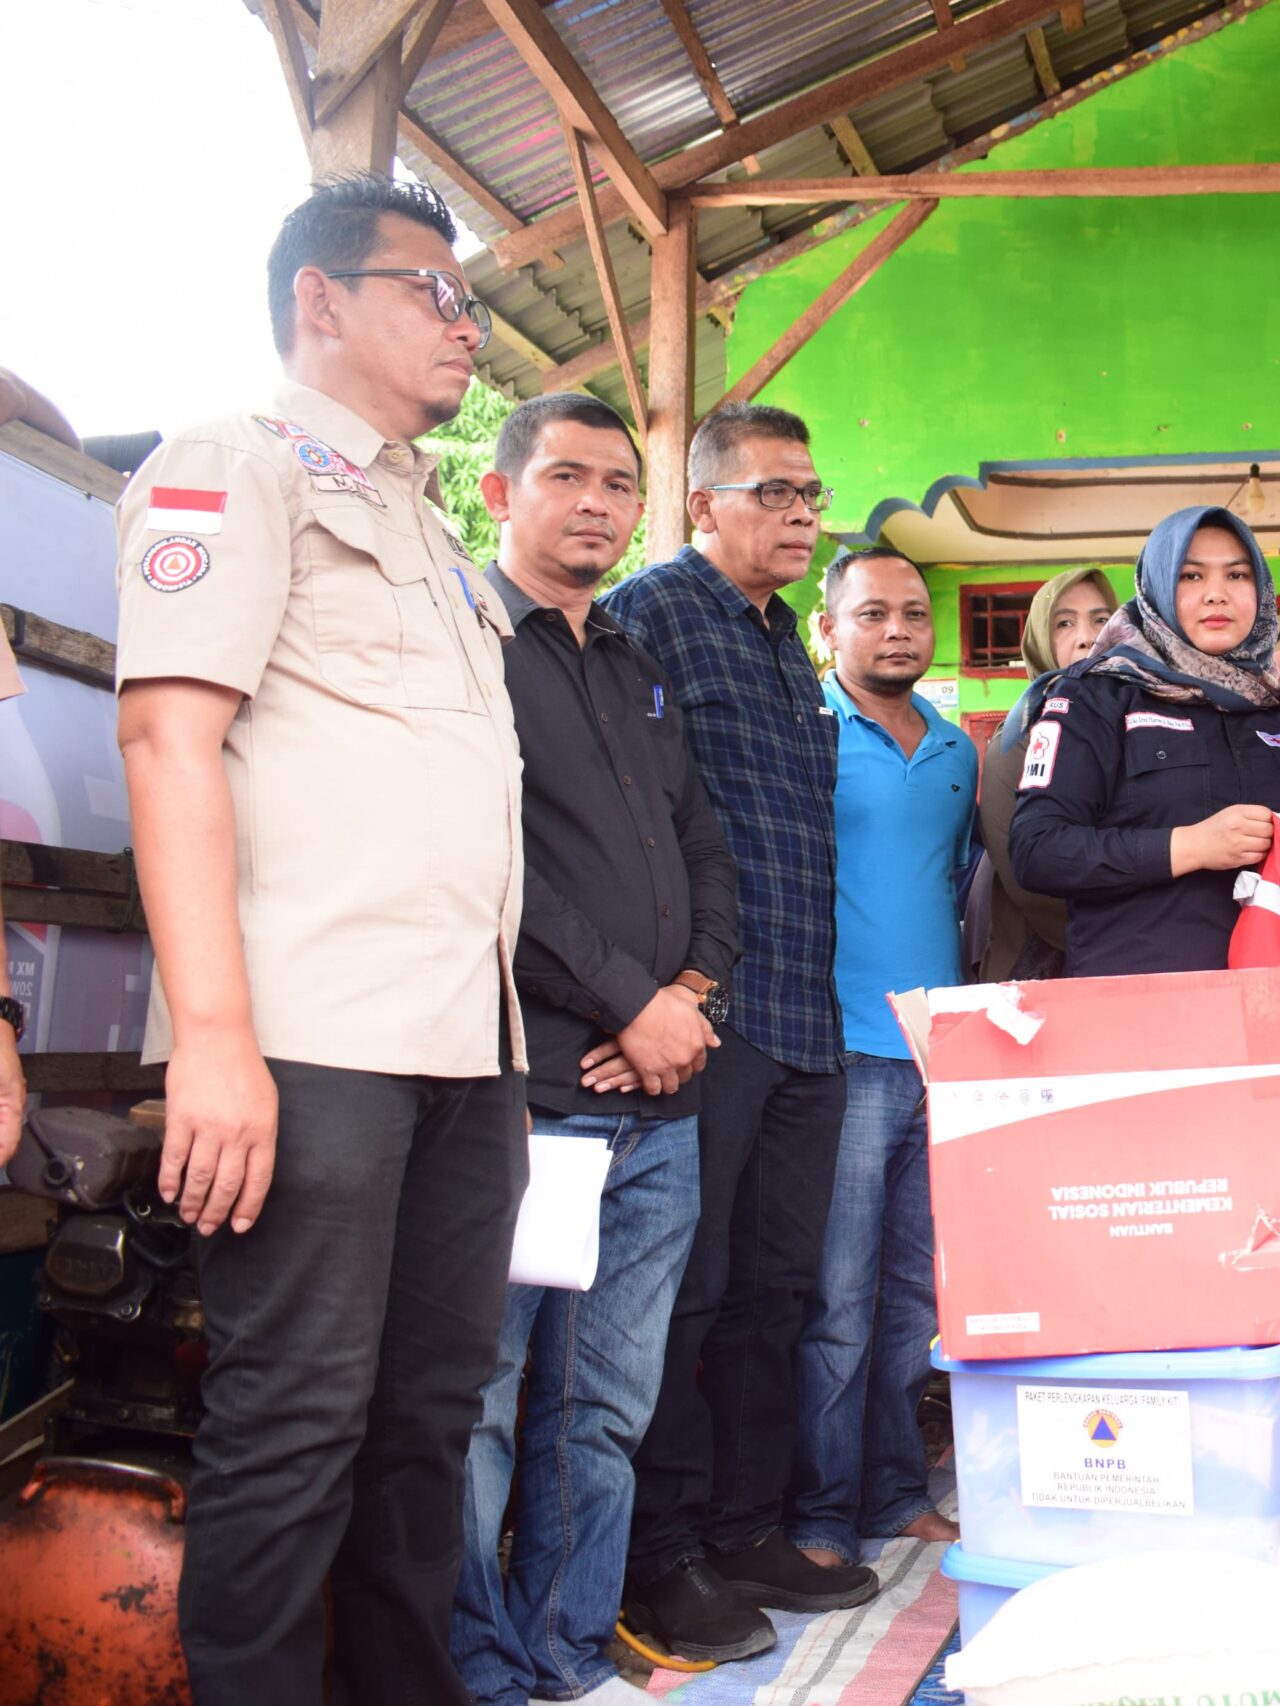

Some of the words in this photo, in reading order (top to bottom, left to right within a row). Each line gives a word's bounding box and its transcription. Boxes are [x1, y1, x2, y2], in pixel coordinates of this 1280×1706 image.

[1050, 1183, 1145, 1201] INDONESIA
[1149, 1178, 1228, 1197] REPUBLIK
[1048, 1203, 1109, 1221] SOSIAL
[1112, 1196, 1232, 1217] KEMENTERIAN
[1109, 1223, 1173, 1238] BANTUAN
[1025, 1391, 1046, 1403] PAKET
[1047, 1392, 1100, 1405] PERLENGKAPAN
[1102, 1393, 1139, 1406] KELUARGA
[1084, 1458, 1126, 1470] BNPB
[1053, 1472, 1098, 1482] BANTUAN
[1100, 1473, 1160, 1484] PEMERINTAH
[1057, 1482, 1103, 1493] REPUBLIK
[1105, 1484, 1156, 1495] INDONESIA
[1031, 1492, 1058, 1502] TIDAK
[1060, 1493, 1092, 1504] UNTUK
